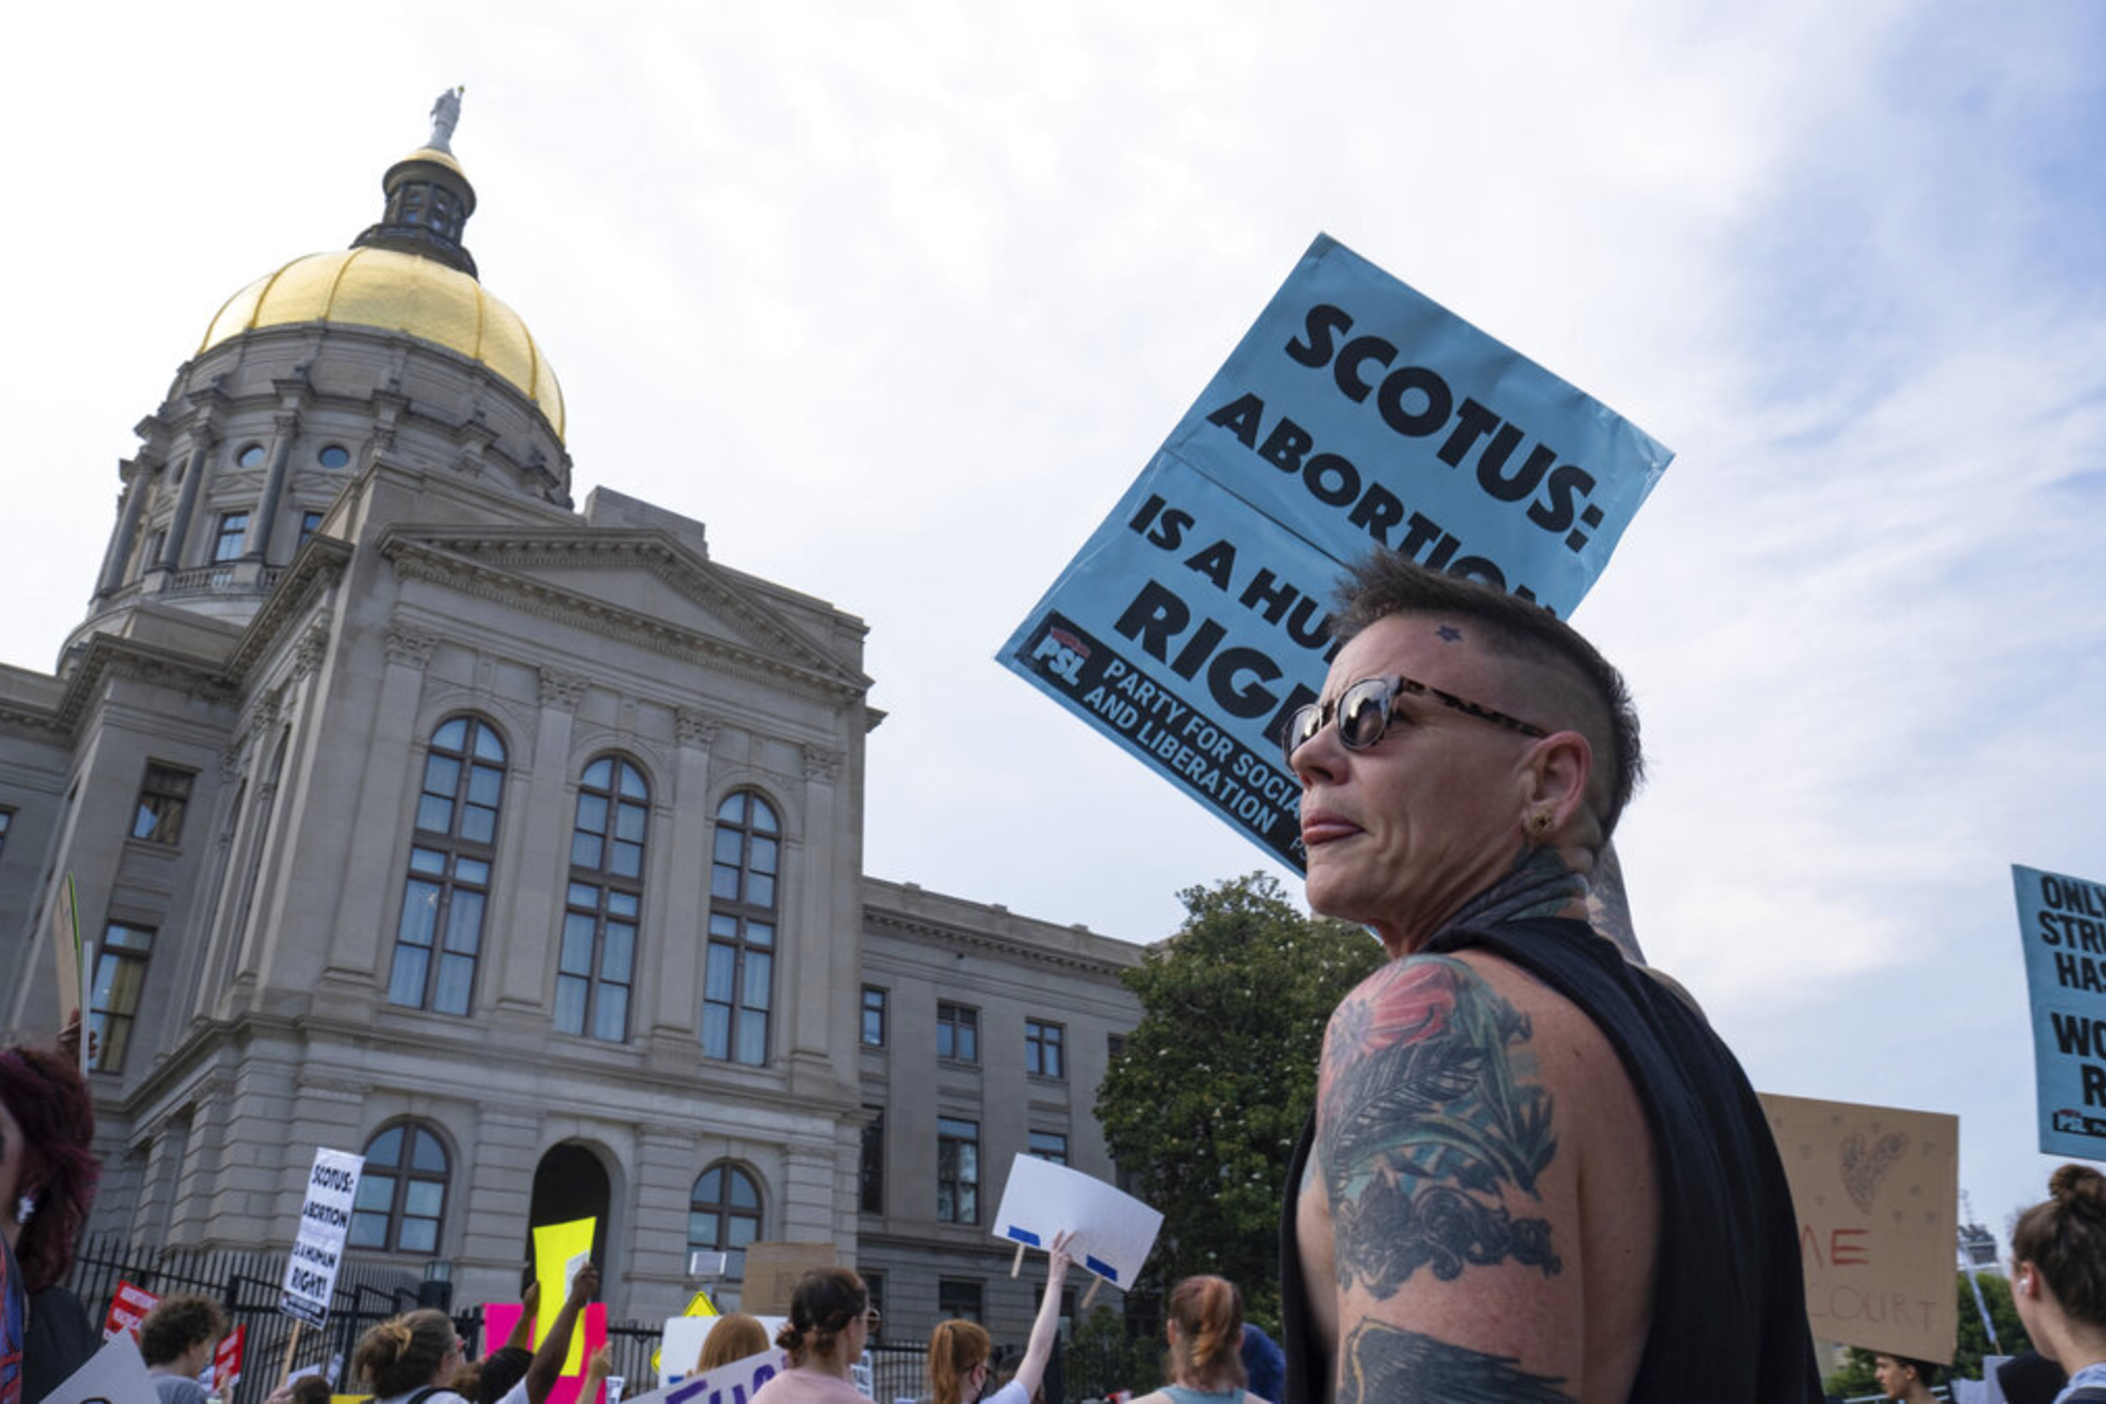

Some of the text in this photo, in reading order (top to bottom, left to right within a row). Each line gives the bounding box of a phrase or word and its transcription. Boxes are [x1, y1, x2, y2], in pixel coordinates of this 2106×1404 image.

[1284, 304, 1604, 553] SCOTUS:
[1206, 392, 1556, 617] ABORTIO
[1129, 493, 1342, 665] IS A HU
[1032, 633, 1088, 687] PSL
[1103, 659, 1186, 725] PARTY
[1182, 716, 1234, 763] FOR
[1084, 686, 1278, 834] AND LIBERATION
[303, 1201, 350, 1229] ABORTION
[311, 1164, 355, 1193] SCOTUS:
[290, 1265, 328, 1300] RIGHT!
